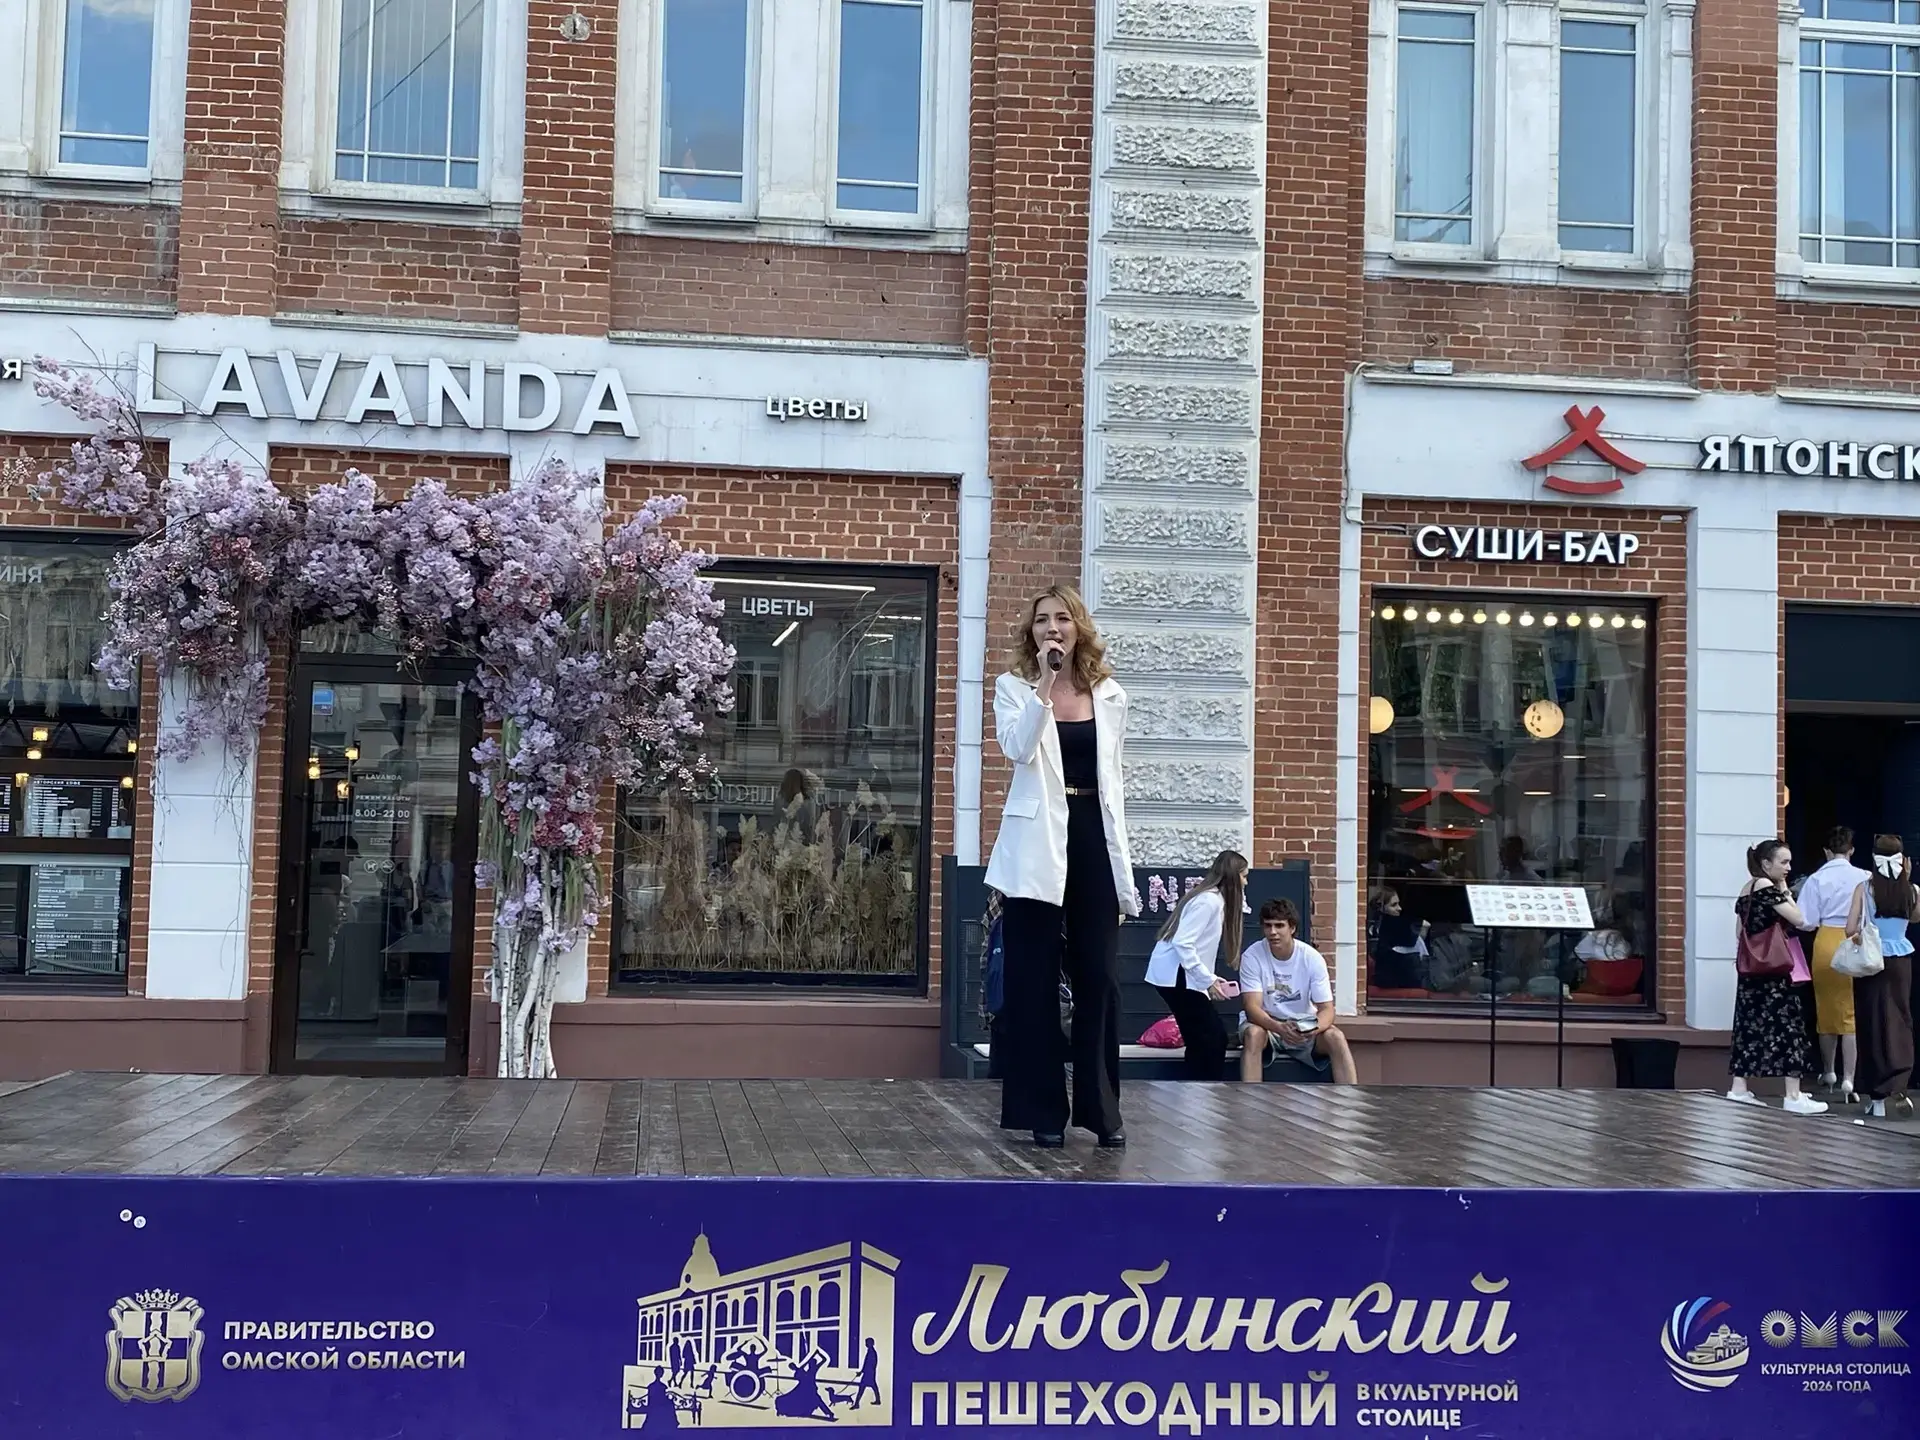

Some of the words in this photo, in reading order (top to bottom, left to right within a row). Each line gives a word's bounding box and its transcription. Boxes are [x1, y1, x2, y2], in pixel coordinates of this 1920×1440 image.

[136, 342, 640, 438] LAVANDA
[766, 395, 868, 421] цветы
[1415, 525, 1640, 565] СУШИ-БАР
[742, 597, 814, 617] ЦВЕТЫ
[912, 1259, 1519, 1355] Любинский
[224, 1321, 435, 1340] ПРАВИТЕЛЬСТВО
[1760, 1309, 1911, 1349] ОМСК
[222, 1346, 339, 1370] ОМСКОЙ
[347, 1350, 466, 1369] ОБЛАСТИ
[1761, 1363, 1843, 1376] КУЛЬТУРНАЯ
[1847, 1363, 1912, 1377] СТОЛИЦА
[1357, 1383, 1370, 1401] В
[1374, 1379, 1519, 1401] КУЛЬТУРНОЙ
[1802, 1380, 1833, 1392] 2026
[1837, 1380, 1872, 1394] ГОДА
[912, 1370, 1337, 1436] ПЕШЕХОДНЫЙ
[1356, 1408, 1462, 1431] СТОЛИЦЕ
